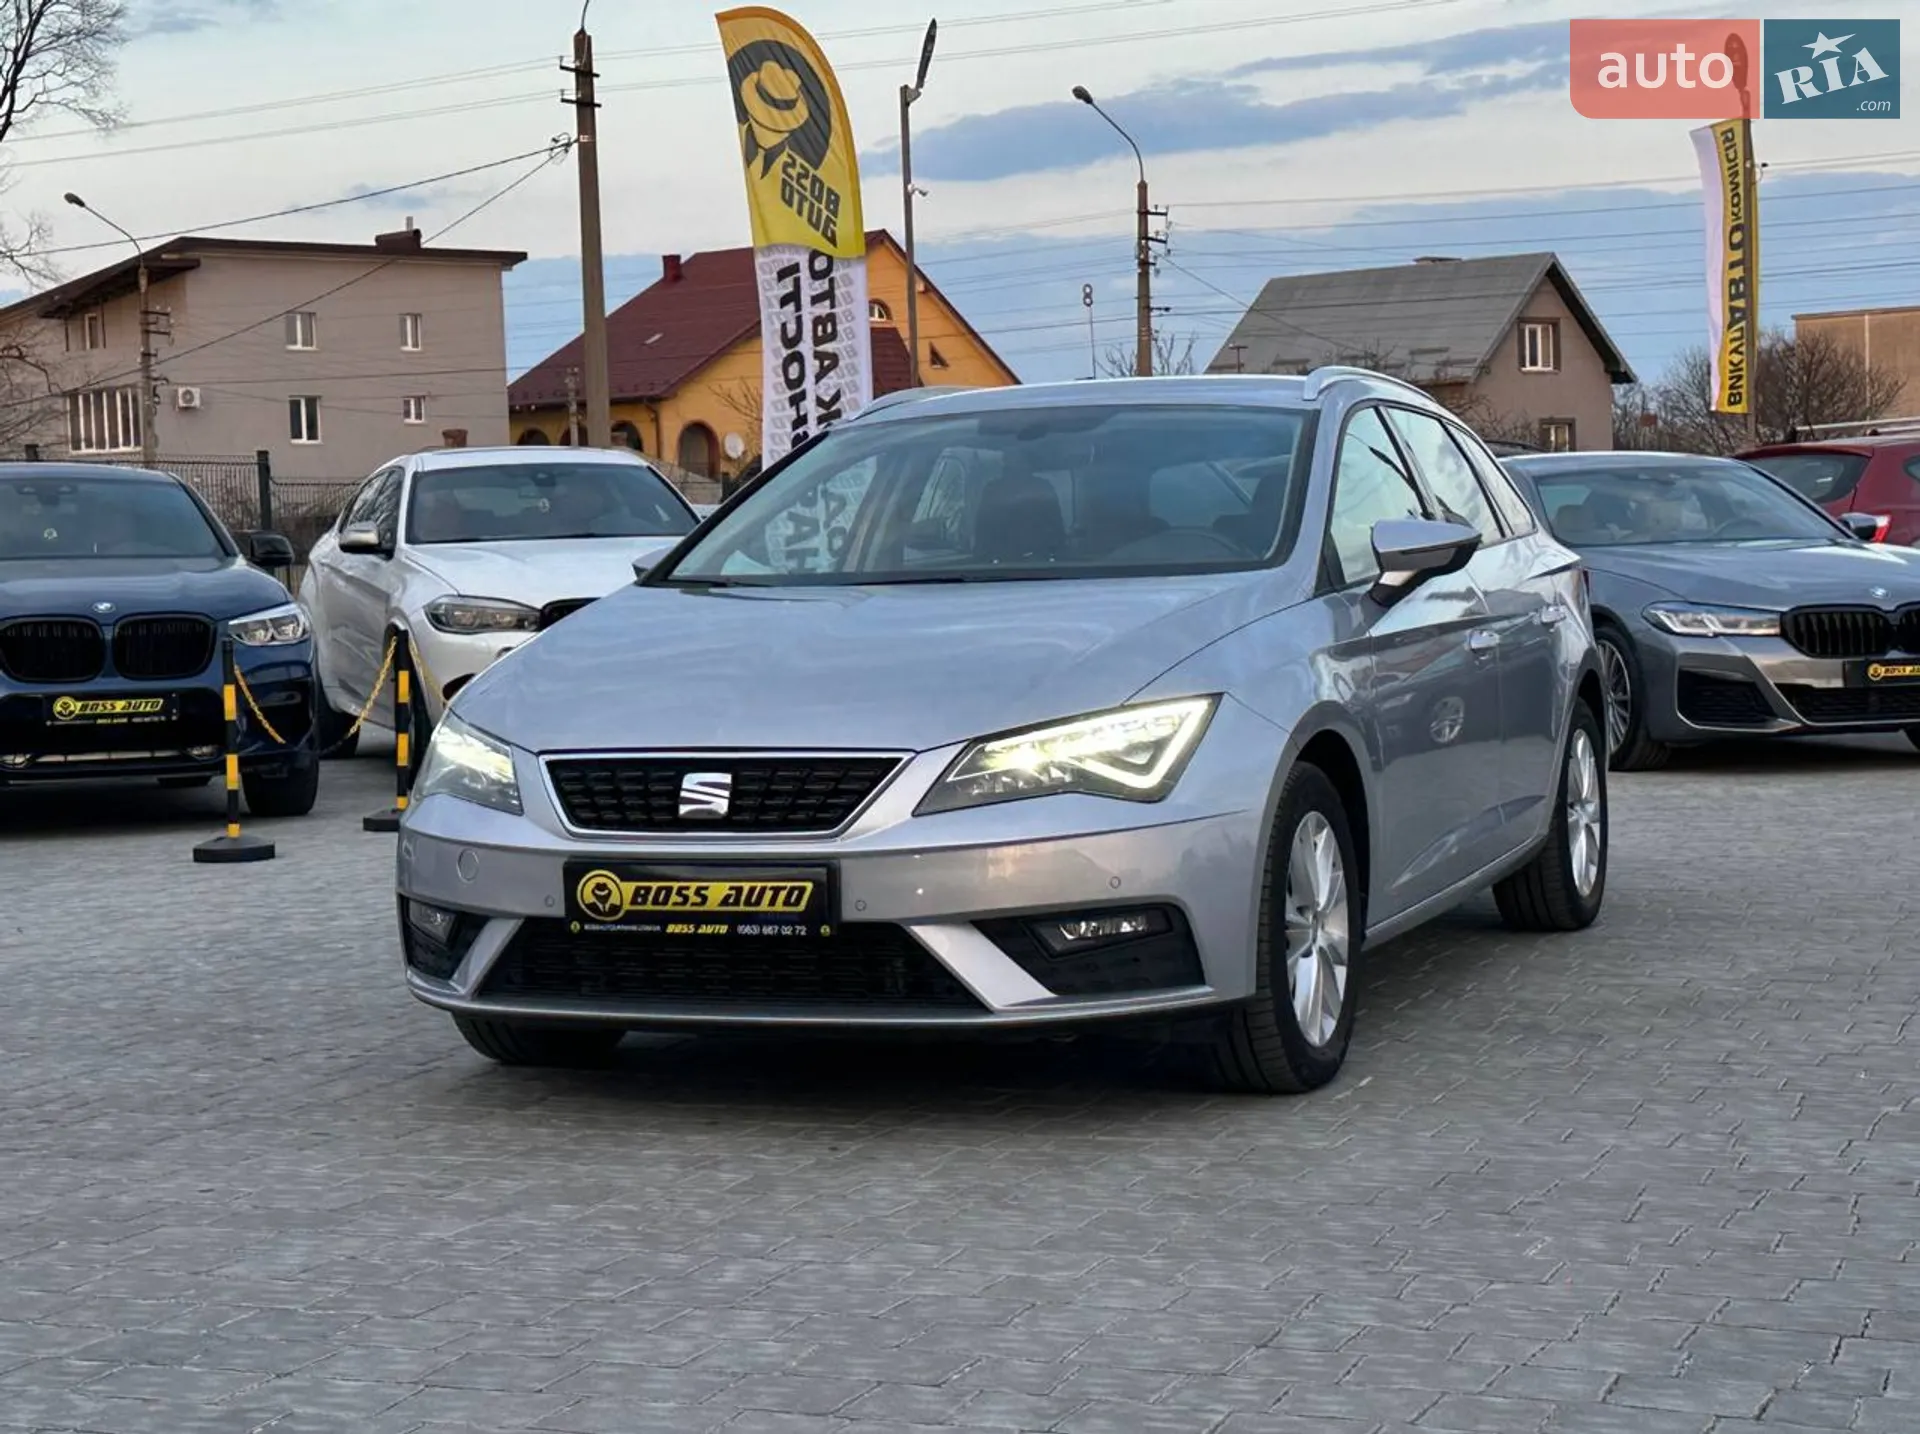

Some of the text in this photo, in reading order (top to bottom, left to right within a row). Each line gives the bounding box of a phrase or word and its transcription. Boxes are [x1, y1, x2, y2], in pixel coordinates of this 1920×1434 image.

[79, 699, 160, 712] BOSS AUTO
[629, 885, 807, 907] BOSS AUTO
[666, 924, 695, 934] BOSS
[698, 924, 729, 934] AUTO
